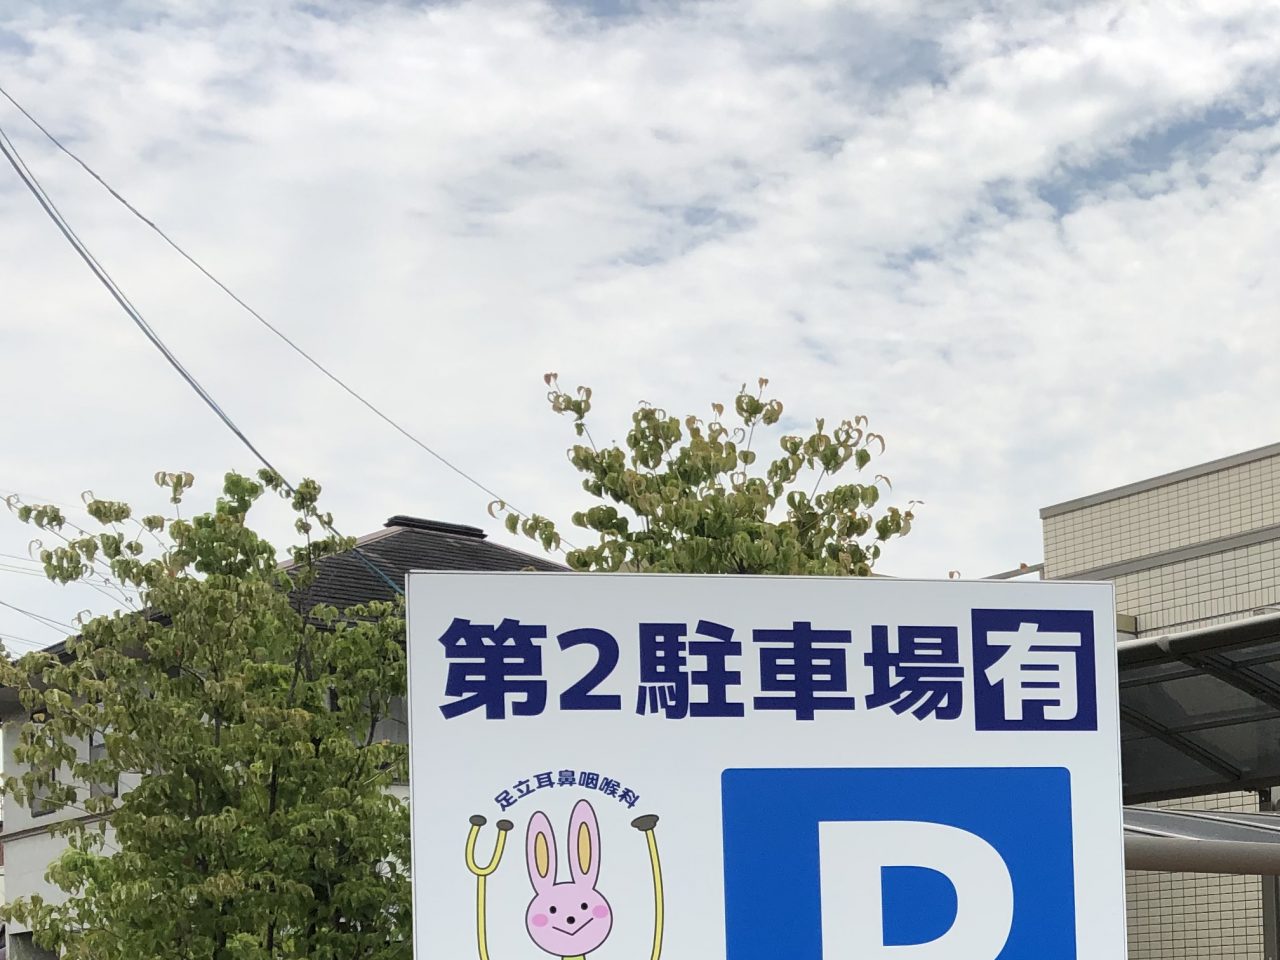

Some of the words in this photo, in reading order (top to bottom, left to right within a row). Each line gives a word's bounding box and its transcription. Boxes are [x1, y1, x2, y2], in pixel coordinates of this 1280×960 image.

[494, 769, 641, 812] 足立耳鼻咽喉科
